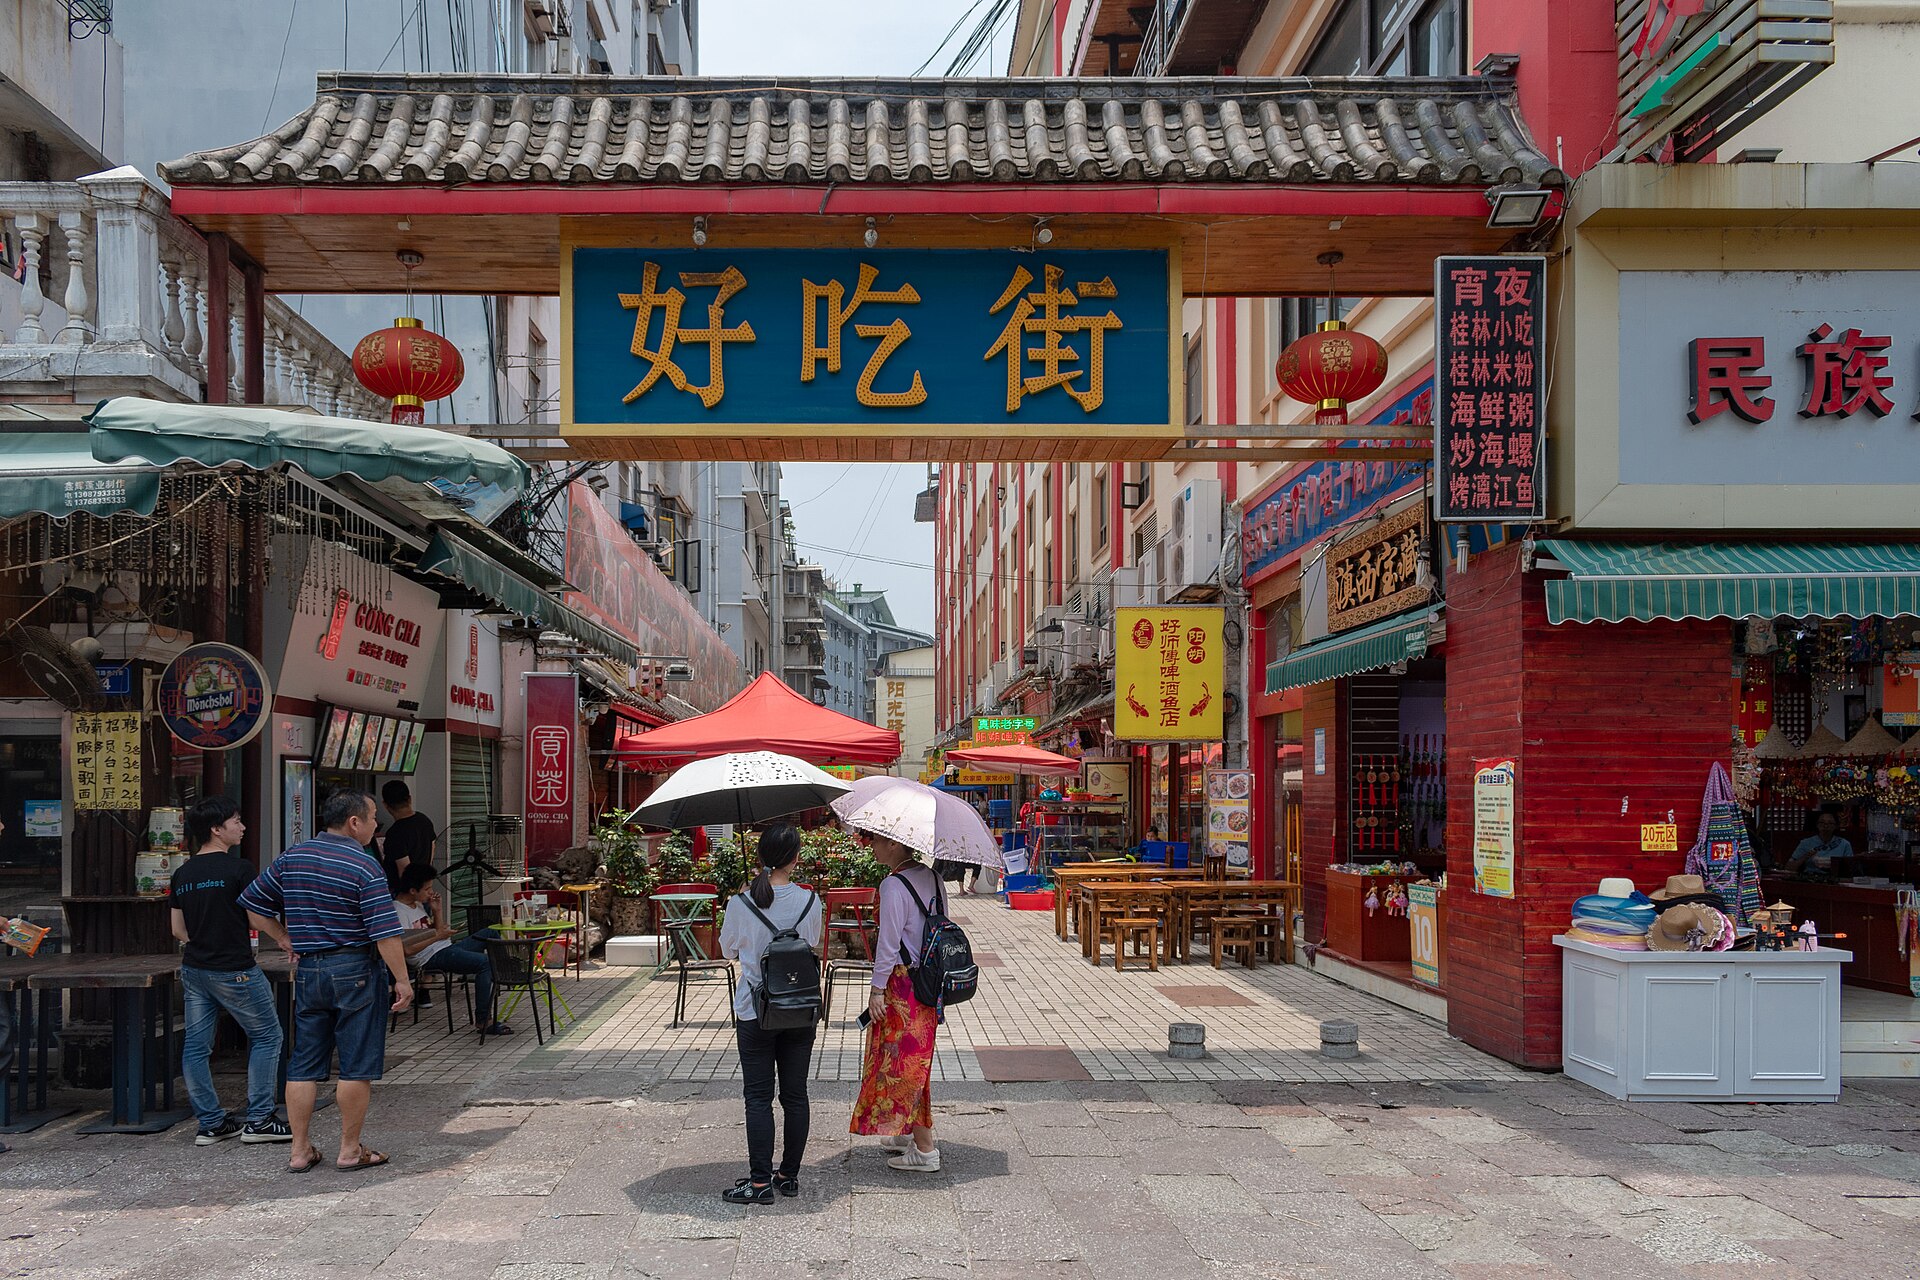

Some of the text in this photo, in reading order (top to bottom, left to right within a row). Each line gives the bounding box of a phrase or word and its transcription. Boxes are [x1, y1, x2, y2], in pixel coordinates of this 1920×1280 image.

[1450, 267, 1533, 307] 宵夜
[617, 261, 1123, 412] 好吃街
[1450, 310, 1534, 347] 桂林小吃
[1450, 350, 1534, 387] 桂林米粉
[1687, 321, 1920, 426] 民族
[1450, 391, 1534, 430] 海鲜粥
[1450, 432, 1534, 469] 炒海螺
[1450, 471, 1534, 510] 烤漓江鱼
[354, 603, 422, 648] GONG CHA
[1187, 628, 1205, 664] 阳朔
[1159, 619, 1181, 728] 好师傅啤酒鱼店
[450, 684, 495, 711] GONG CHA
[76, 716, 139, 736] 高薪招聘
[527, 812, 569, 820] GONG CHA
[1642, 826, 1675, 842] 20元区
[196, 879, 225, 890] modest
